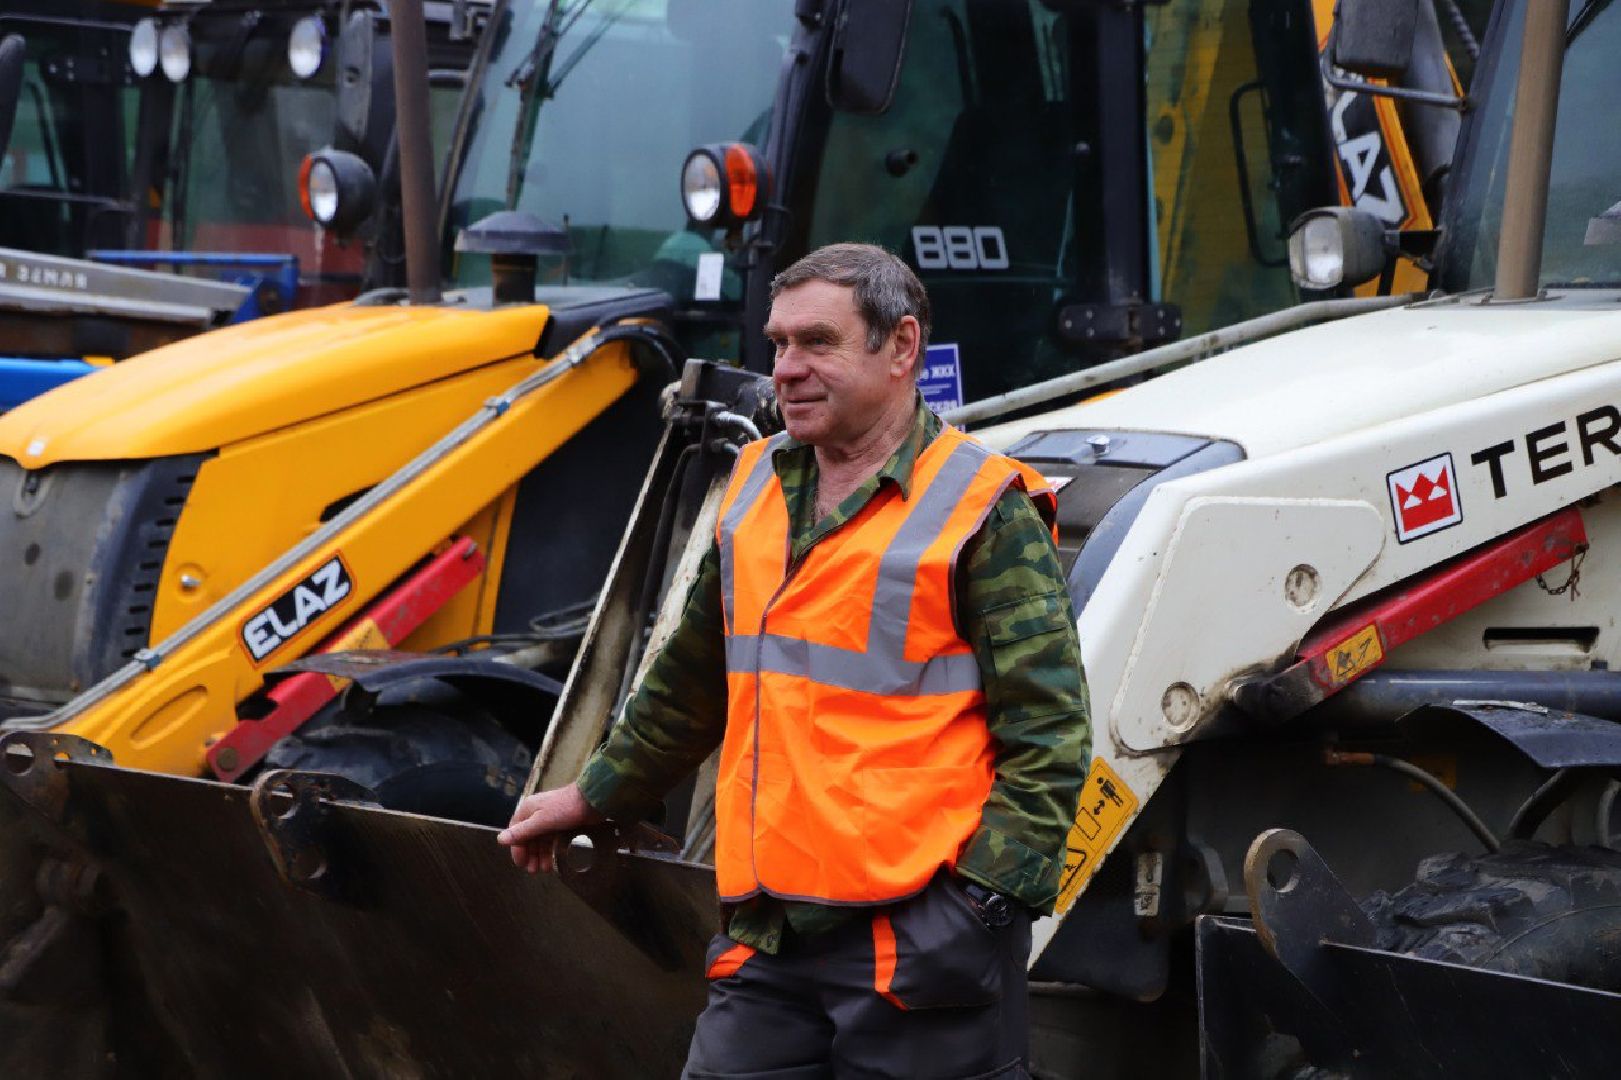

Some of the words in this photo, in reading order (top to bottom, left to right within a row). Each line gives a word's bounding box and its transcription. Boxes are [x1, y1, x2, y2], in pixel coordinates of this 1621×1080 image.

[912, 226, 1009, 269] 880
[1470, 405, 1621, 499] TER
[243, 559, 350, 659] ELAZ
